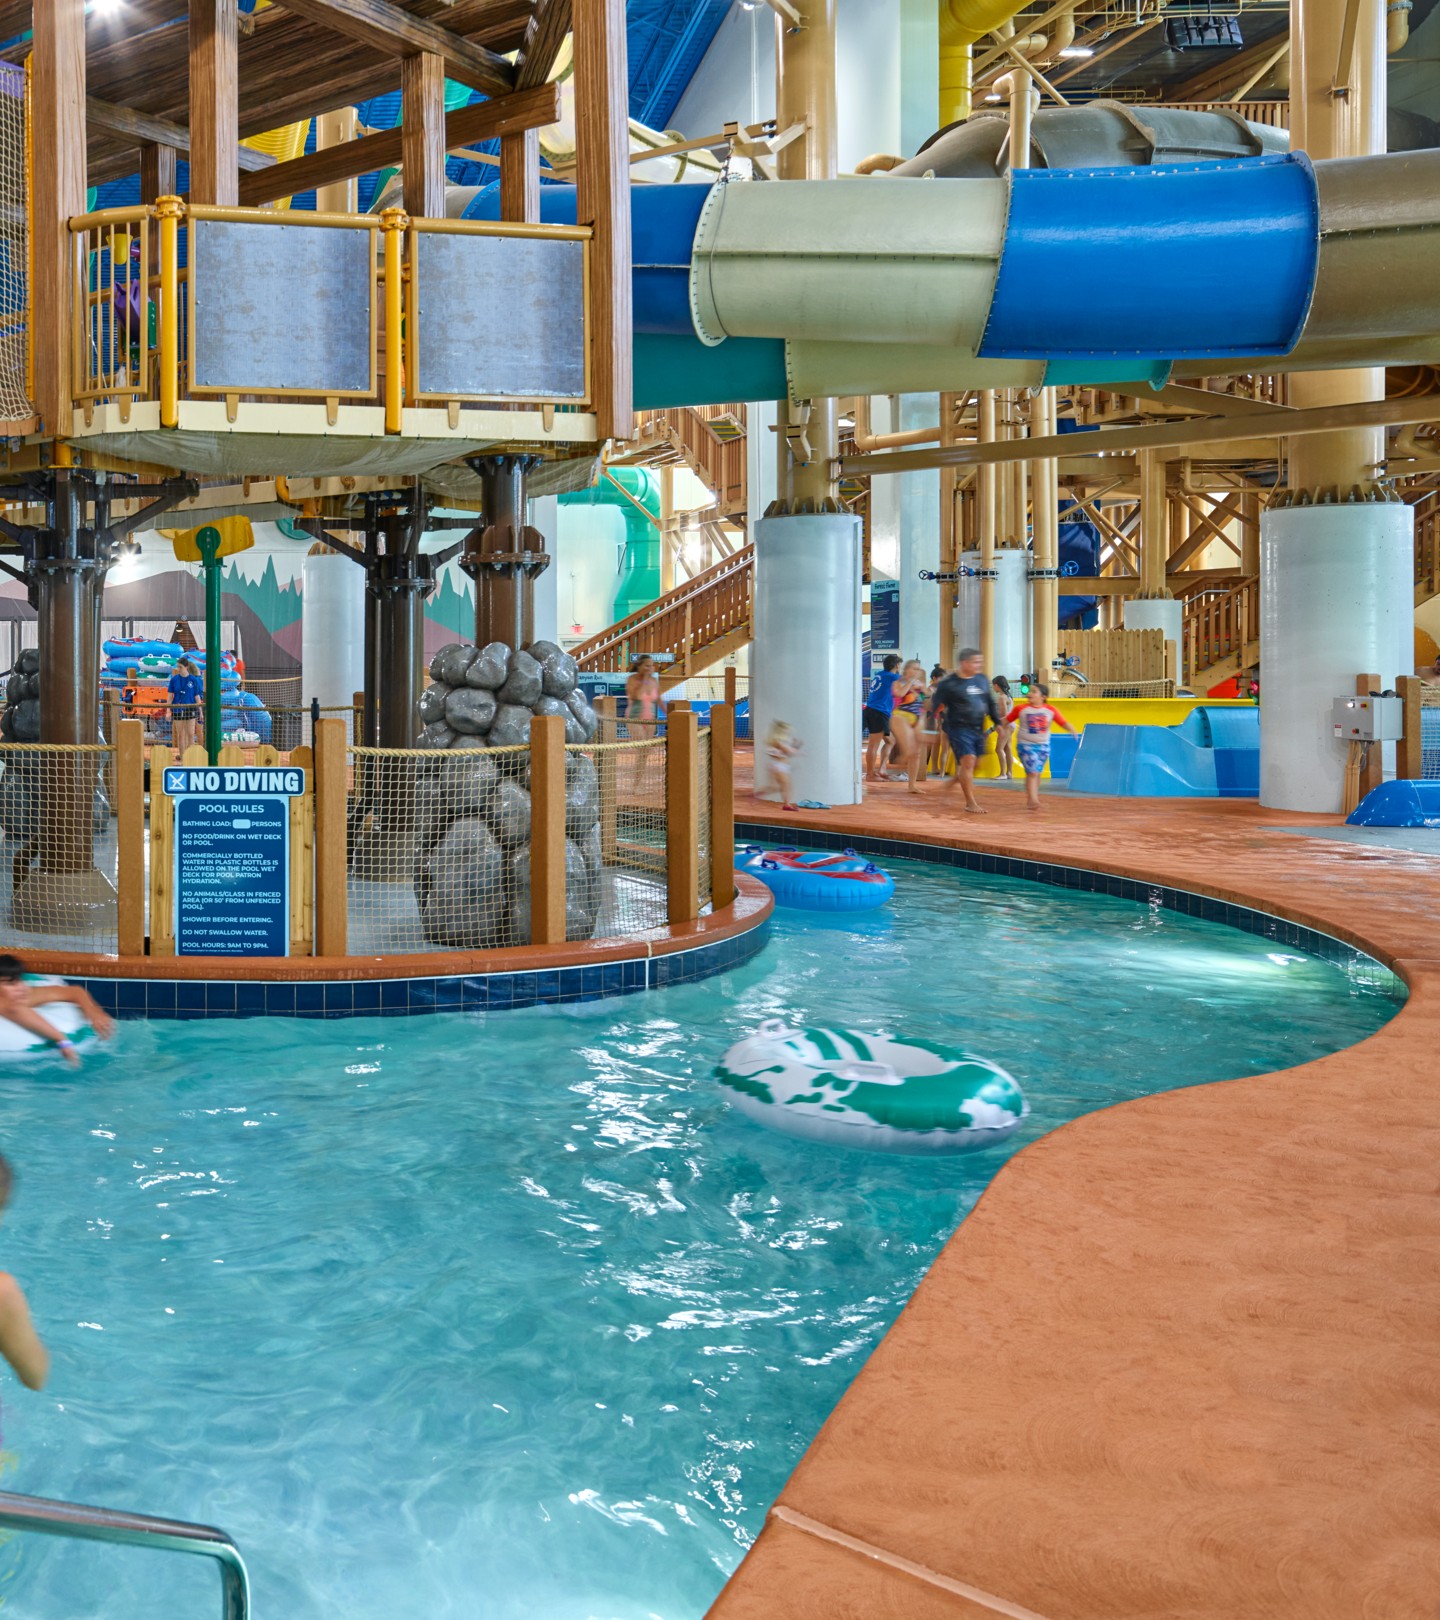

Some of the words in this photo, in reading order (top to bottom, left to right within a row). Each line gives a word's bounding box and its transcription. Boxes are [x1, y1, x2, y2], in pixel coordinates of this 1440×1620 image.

[190, 772, 220, 792] NO
[224, 772, 299, 792] DIVING
[199, 804, 229, 813] POOL
[231, 804, 264, 813] RULES
